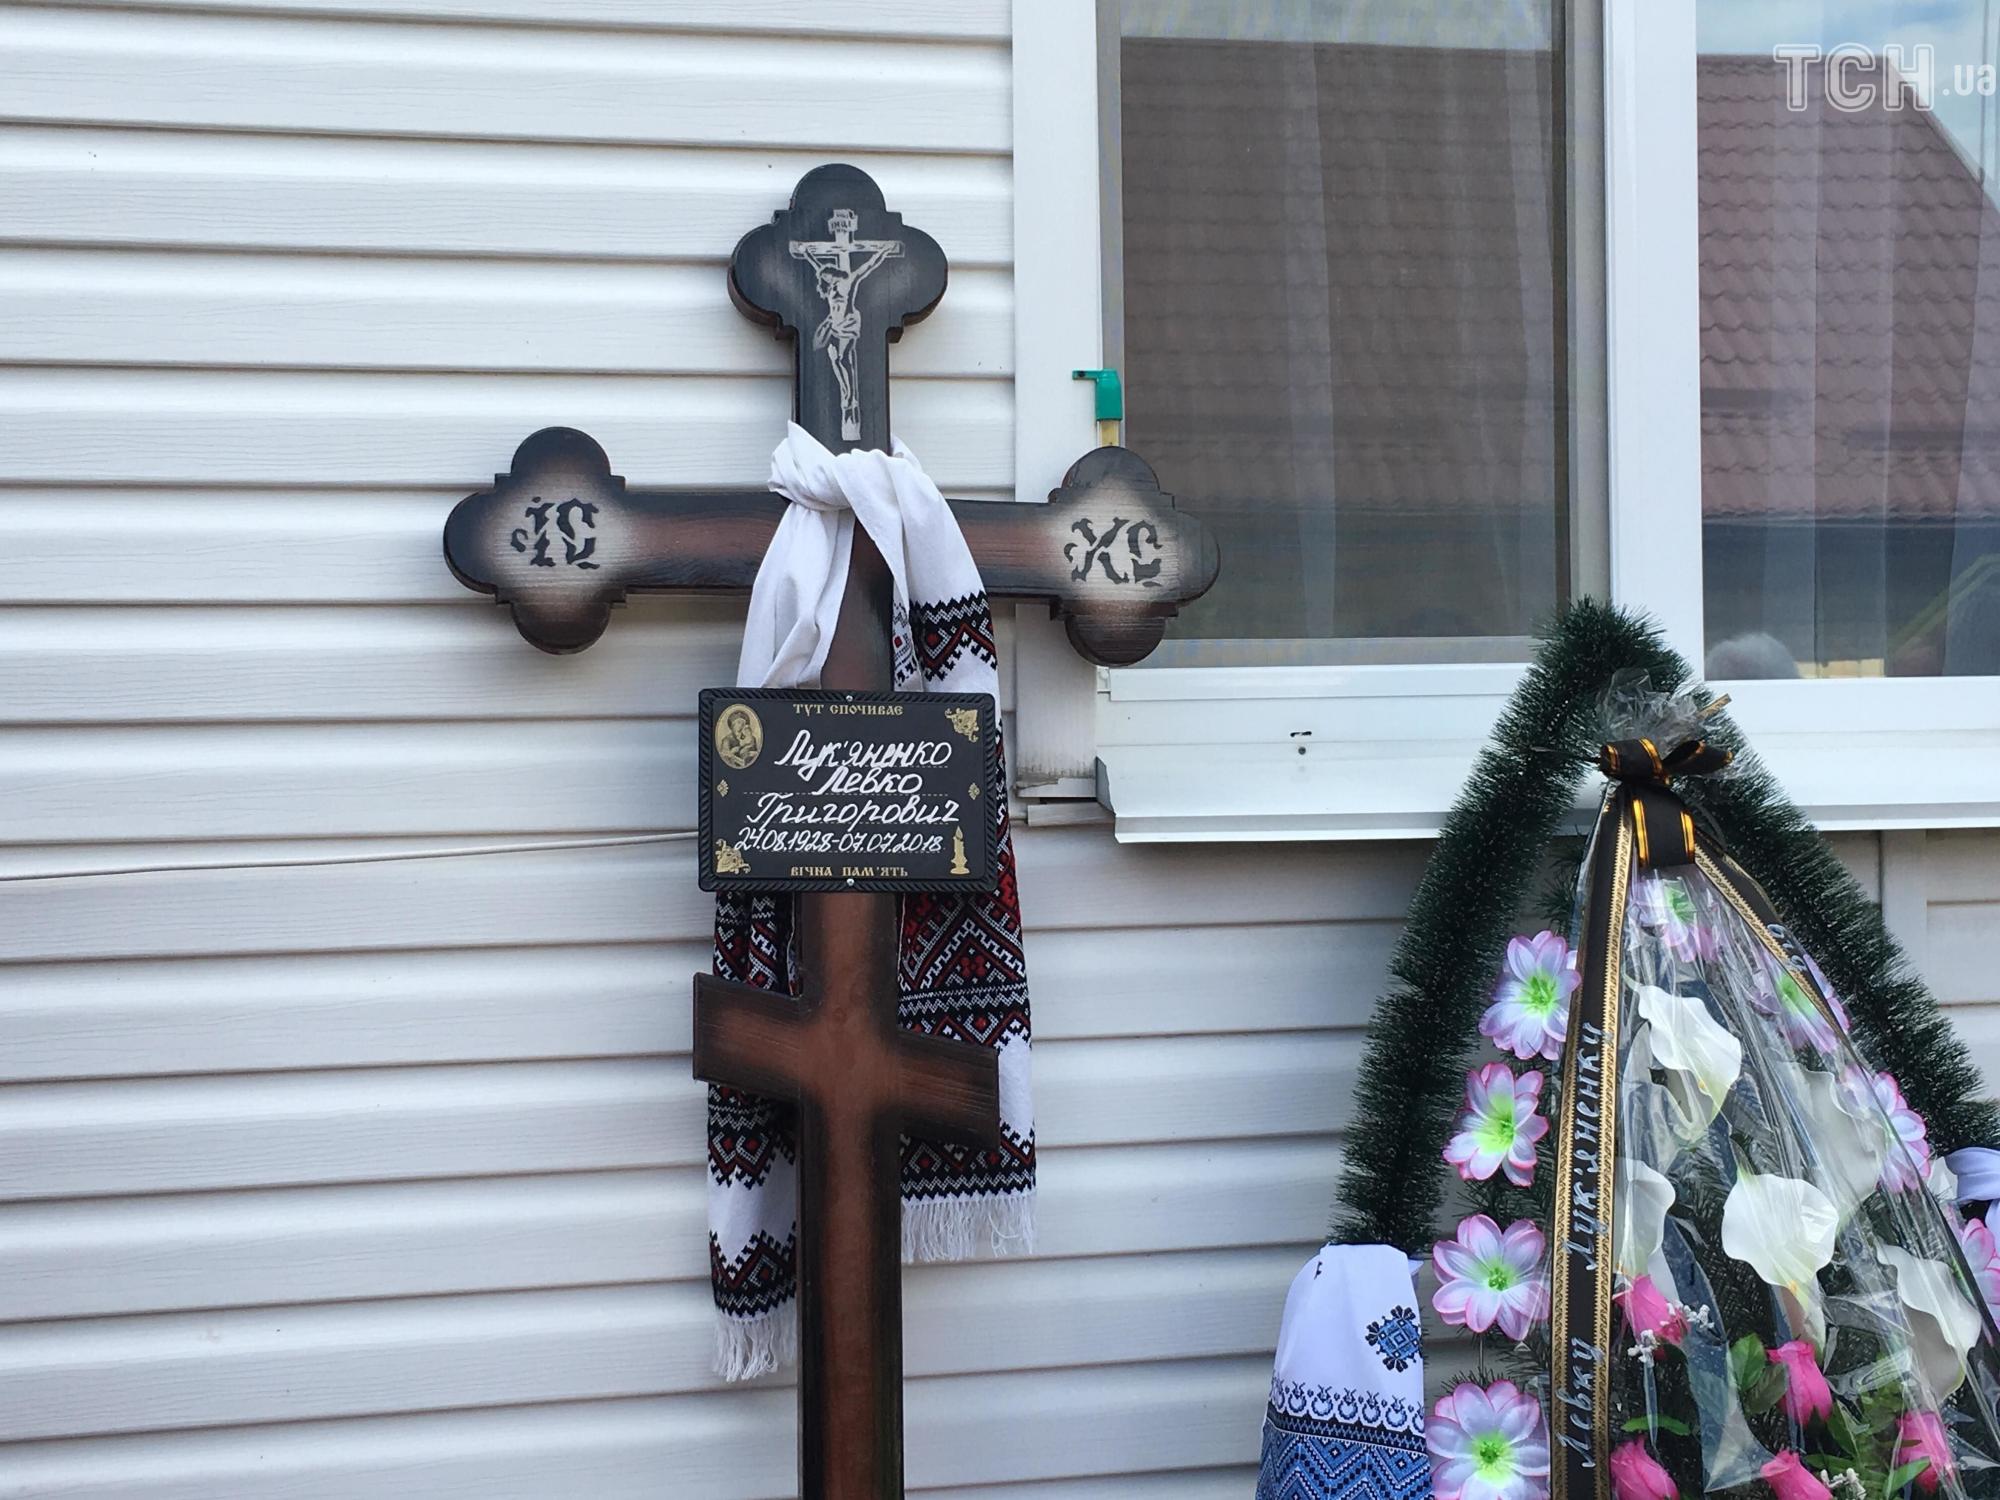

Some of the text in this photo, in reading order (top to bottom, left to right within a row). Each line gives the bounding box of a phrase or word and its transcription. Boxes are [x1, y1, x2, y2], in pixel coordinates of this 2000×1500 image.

[793, 703, 904, 716] ТУТ СПОЧИВАЄ
[774, 729, 952, 781] Лук'яненко
[812, 766, 923, 796] Левко
[746, 792, 960, 832] Григорович
[790, 866, 833, 877] ВІЧНА
[1556, 1337, 1605, 1468] Левку
